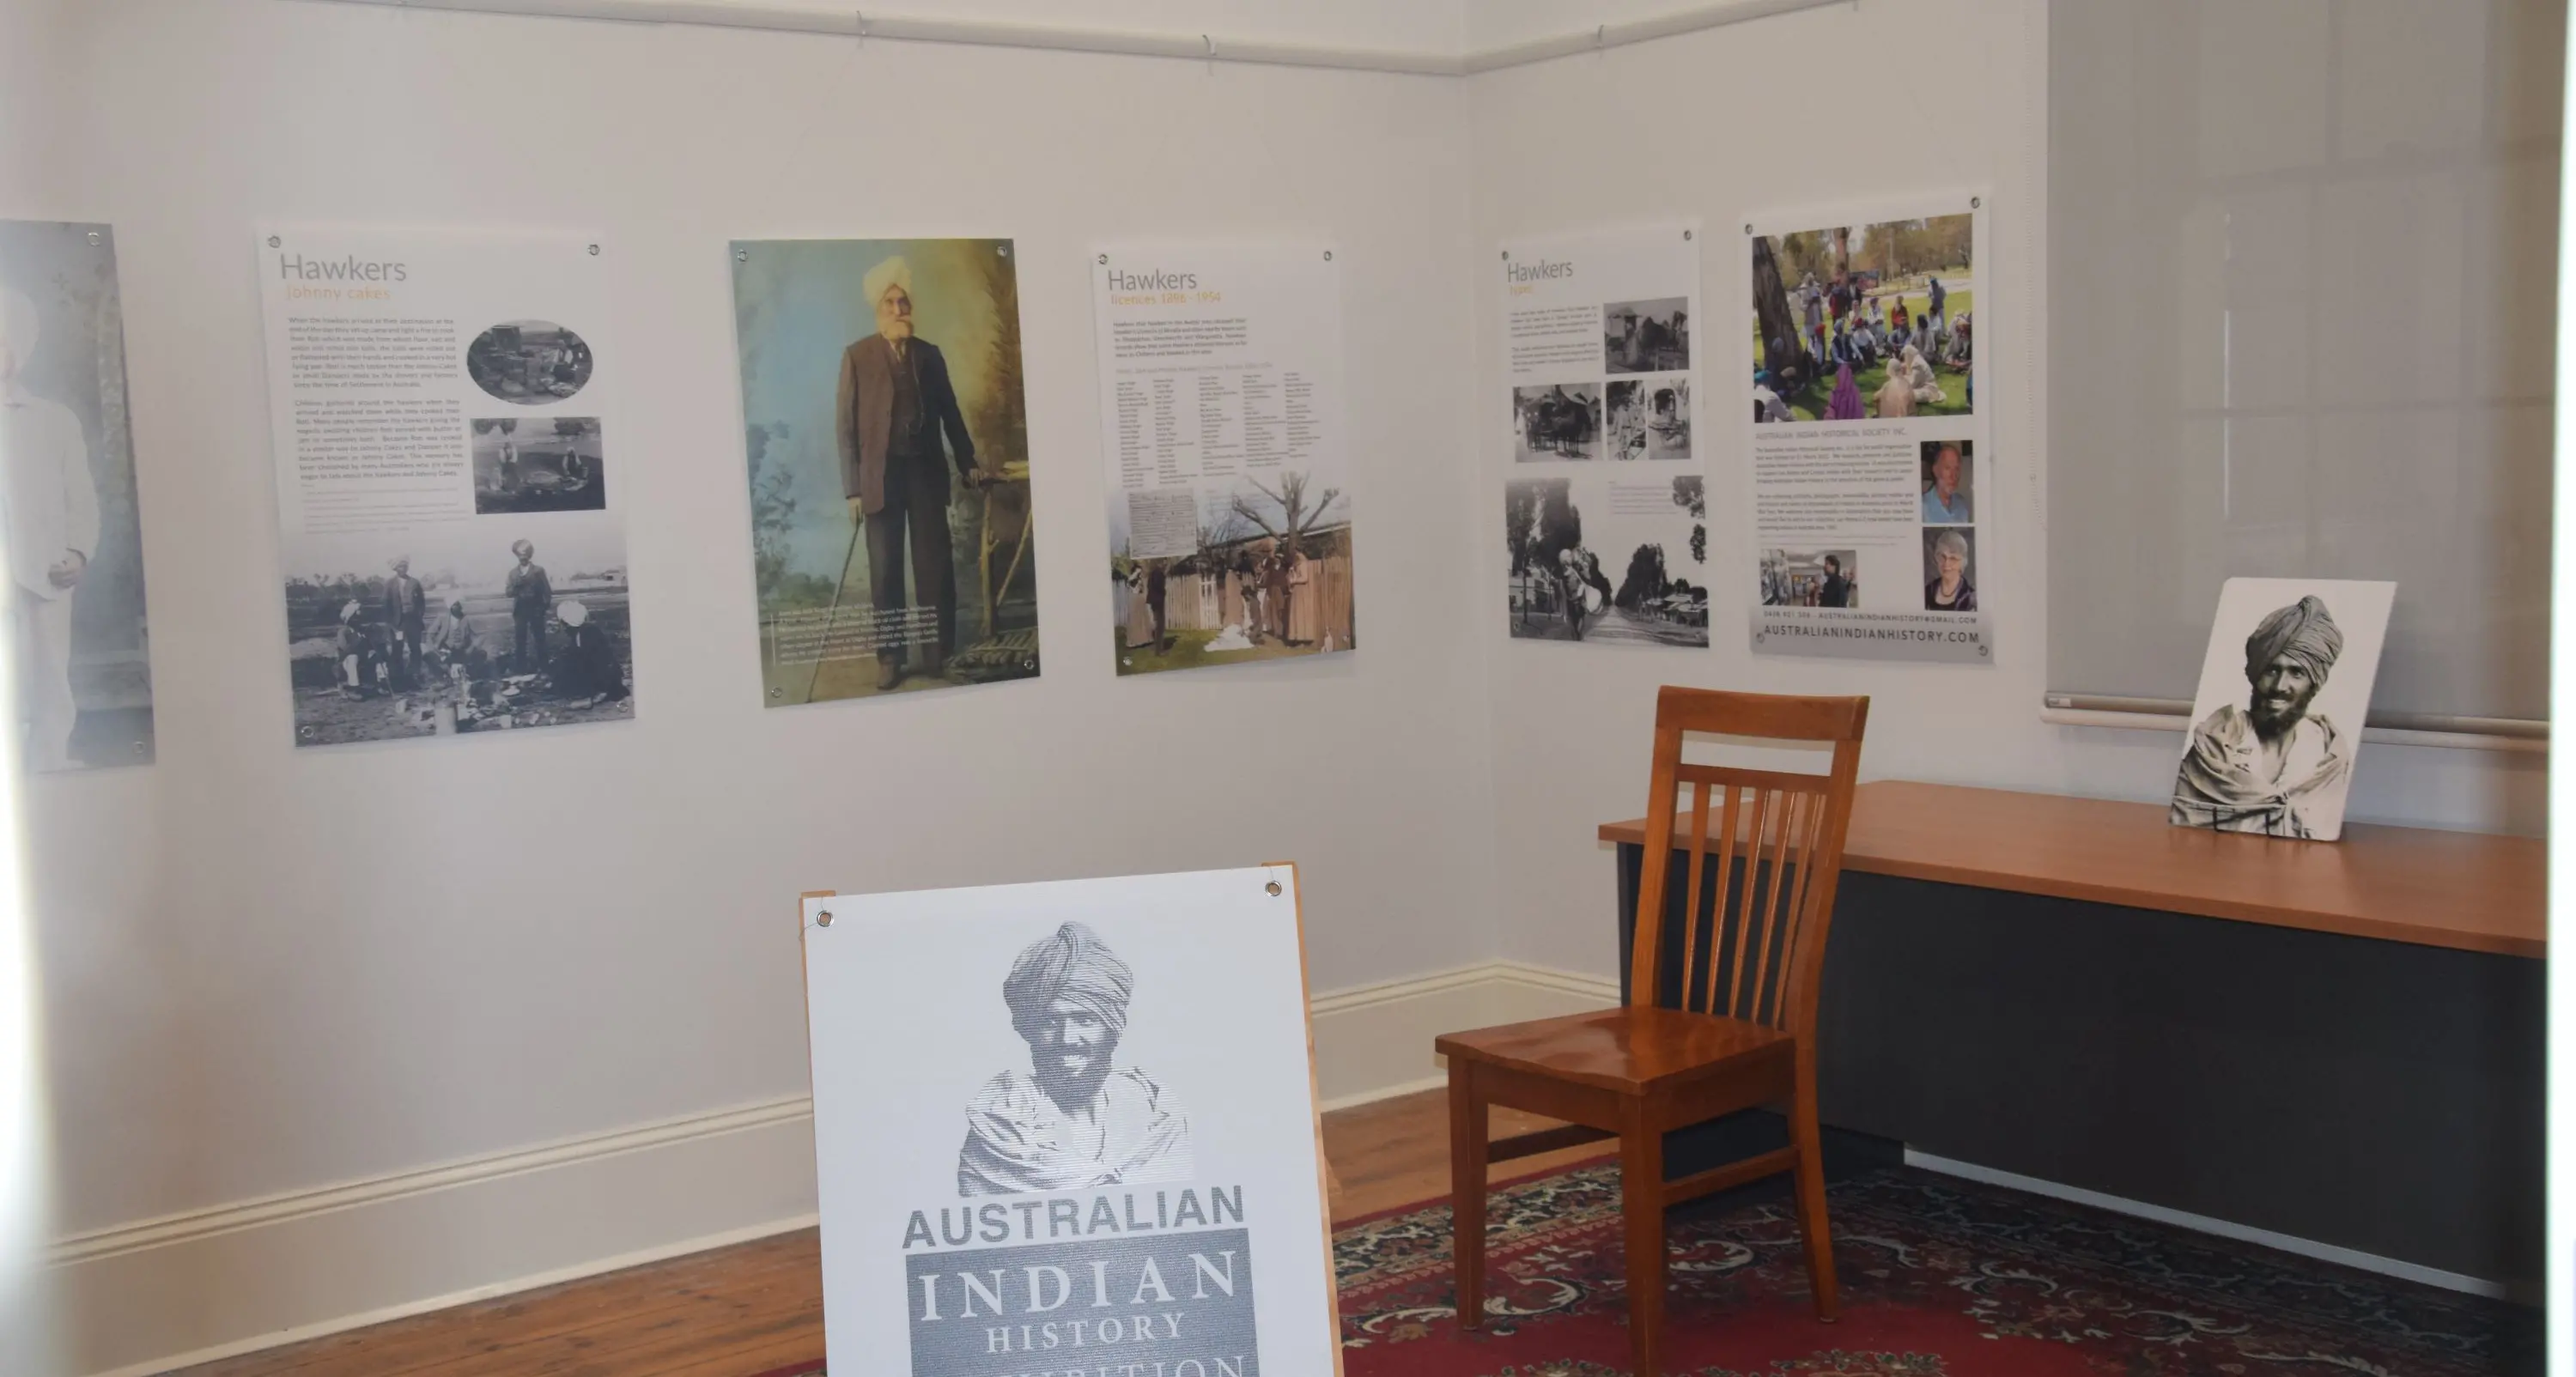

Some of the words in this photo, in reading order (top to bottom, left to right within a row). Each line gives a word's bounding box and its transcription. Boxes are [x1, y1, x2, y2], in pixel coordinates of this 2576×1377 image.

[280, 252, 407, 282] Hawkers
[1108, 268, 1198, 290] Hawkers
[1508, 258, 1573, 282] Hawkers
[1765, 625, 1979, 643] AUSTRALIANINDIANHISTORY.COM
[902, 1185, 1244, 1249] AUSTRALIAN
[919, 1251, 1236, 1321] INDIAN
[986, 1313, 1185, 1353] HISTORY
